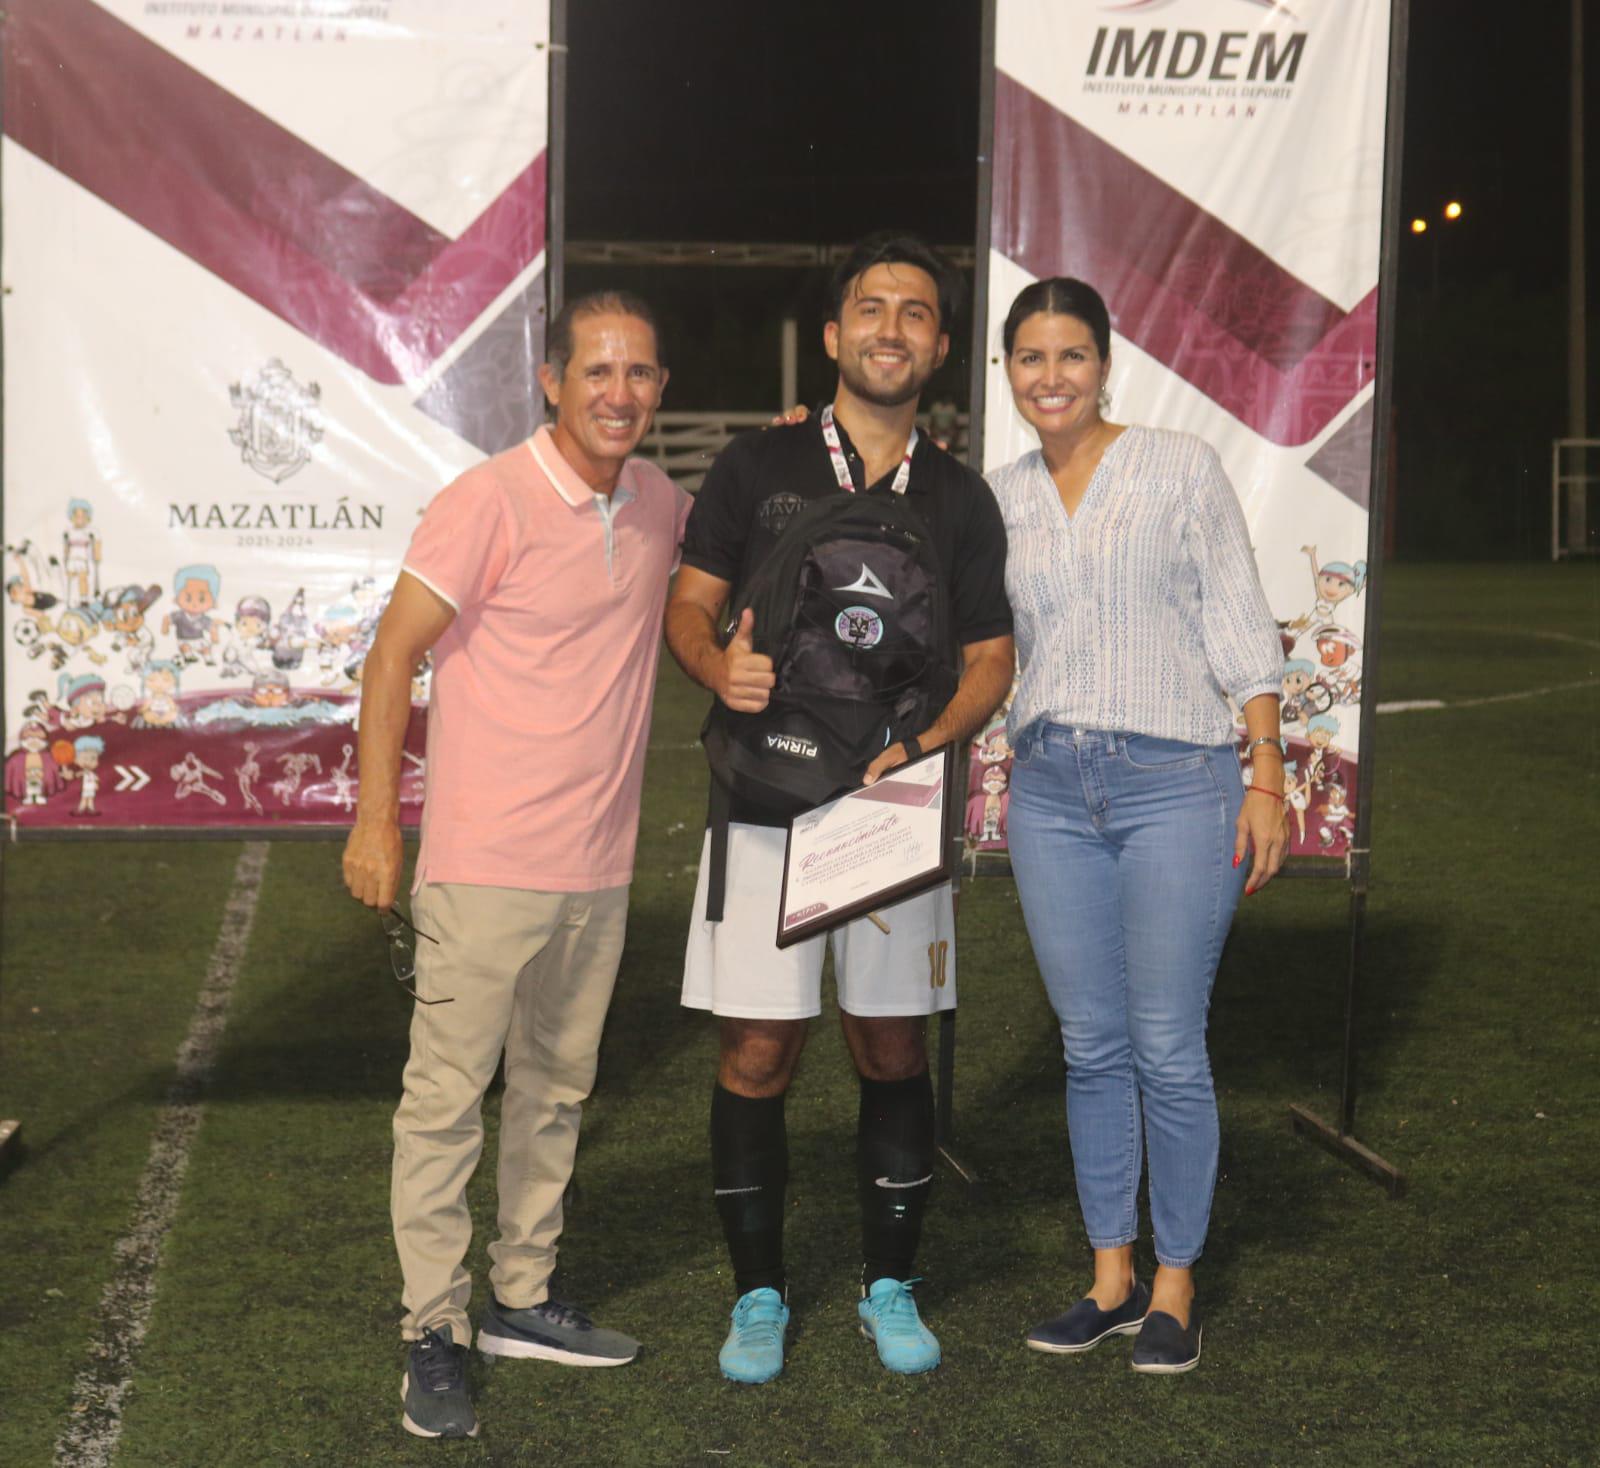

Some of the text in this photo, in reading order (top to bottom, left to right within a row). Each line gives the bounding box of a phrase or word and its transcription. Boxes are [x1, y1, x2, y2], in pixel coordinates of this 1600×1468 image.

[1085, 27, 1308, 82] IMDEM
[1083, 81, 1293, 100] INSTITUTO MUNICIPAL DEL DEPORTE
[169, 496, 384, 529] MAZATLÁN
[237, 535, 314, 547] 2021-2024
[767, 735, 818, 757] PIRMA
[927, 940, 948, 990] 10
